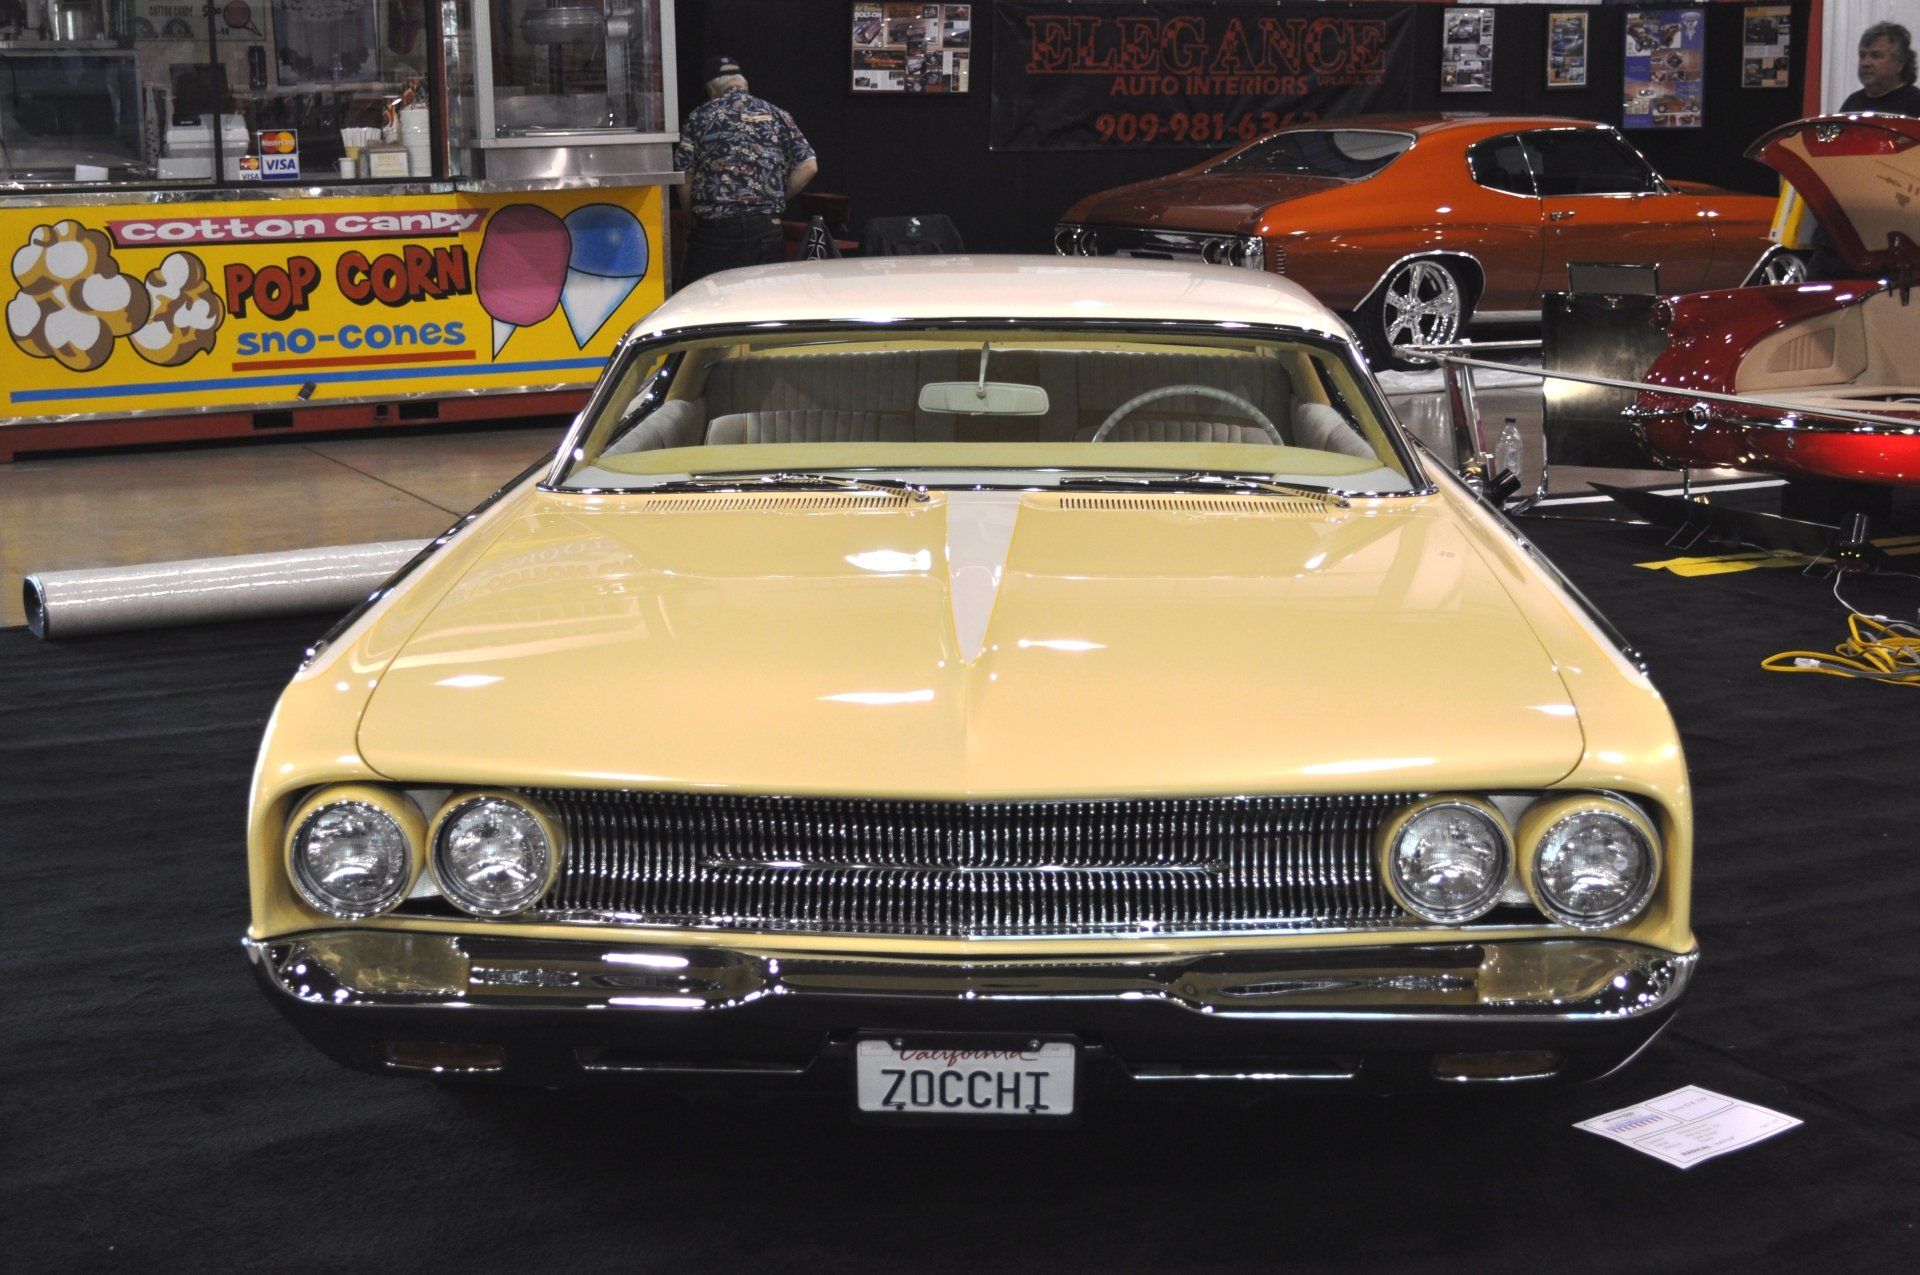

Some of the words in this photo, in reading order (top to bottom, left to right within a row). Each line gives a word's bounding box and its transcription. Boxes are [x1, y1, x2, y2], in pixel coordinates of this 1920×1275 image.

[1026, 15, 1387, 75] ELEGANCE
[1110, 76, 1179, 96] AUTO
[1185, 76, 1308, 97] INTERIORS
[266, 158, 296, 171] VISA
[121, 217, 328, 241] cotton
[223, 255, 321, 321] POP
[336, 244, 473, 308] CORN
[236, 321, 466, 356] sno-cones
